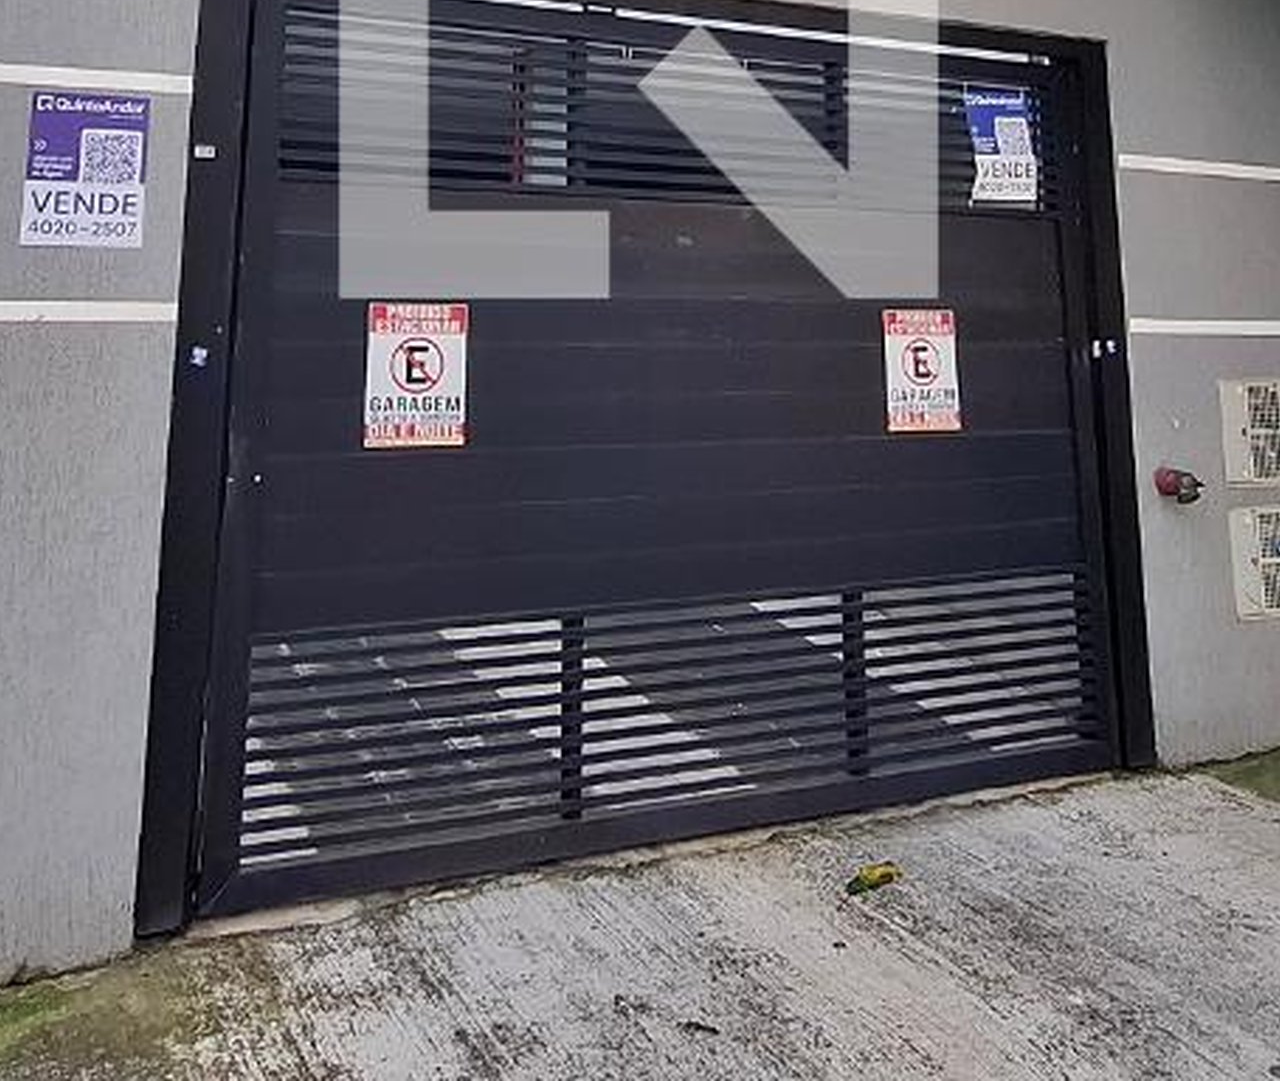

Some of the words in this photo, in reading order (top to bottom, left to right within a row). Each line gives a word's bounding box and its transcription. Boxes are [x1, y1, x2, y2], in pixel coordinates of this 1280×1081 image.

[31, 190, 138, 216] VENDE
[27, 219, 137, 238] 4020-2507
[405, 345, 429, 384] E
[370, 395, 461, 413] GARAGEM
